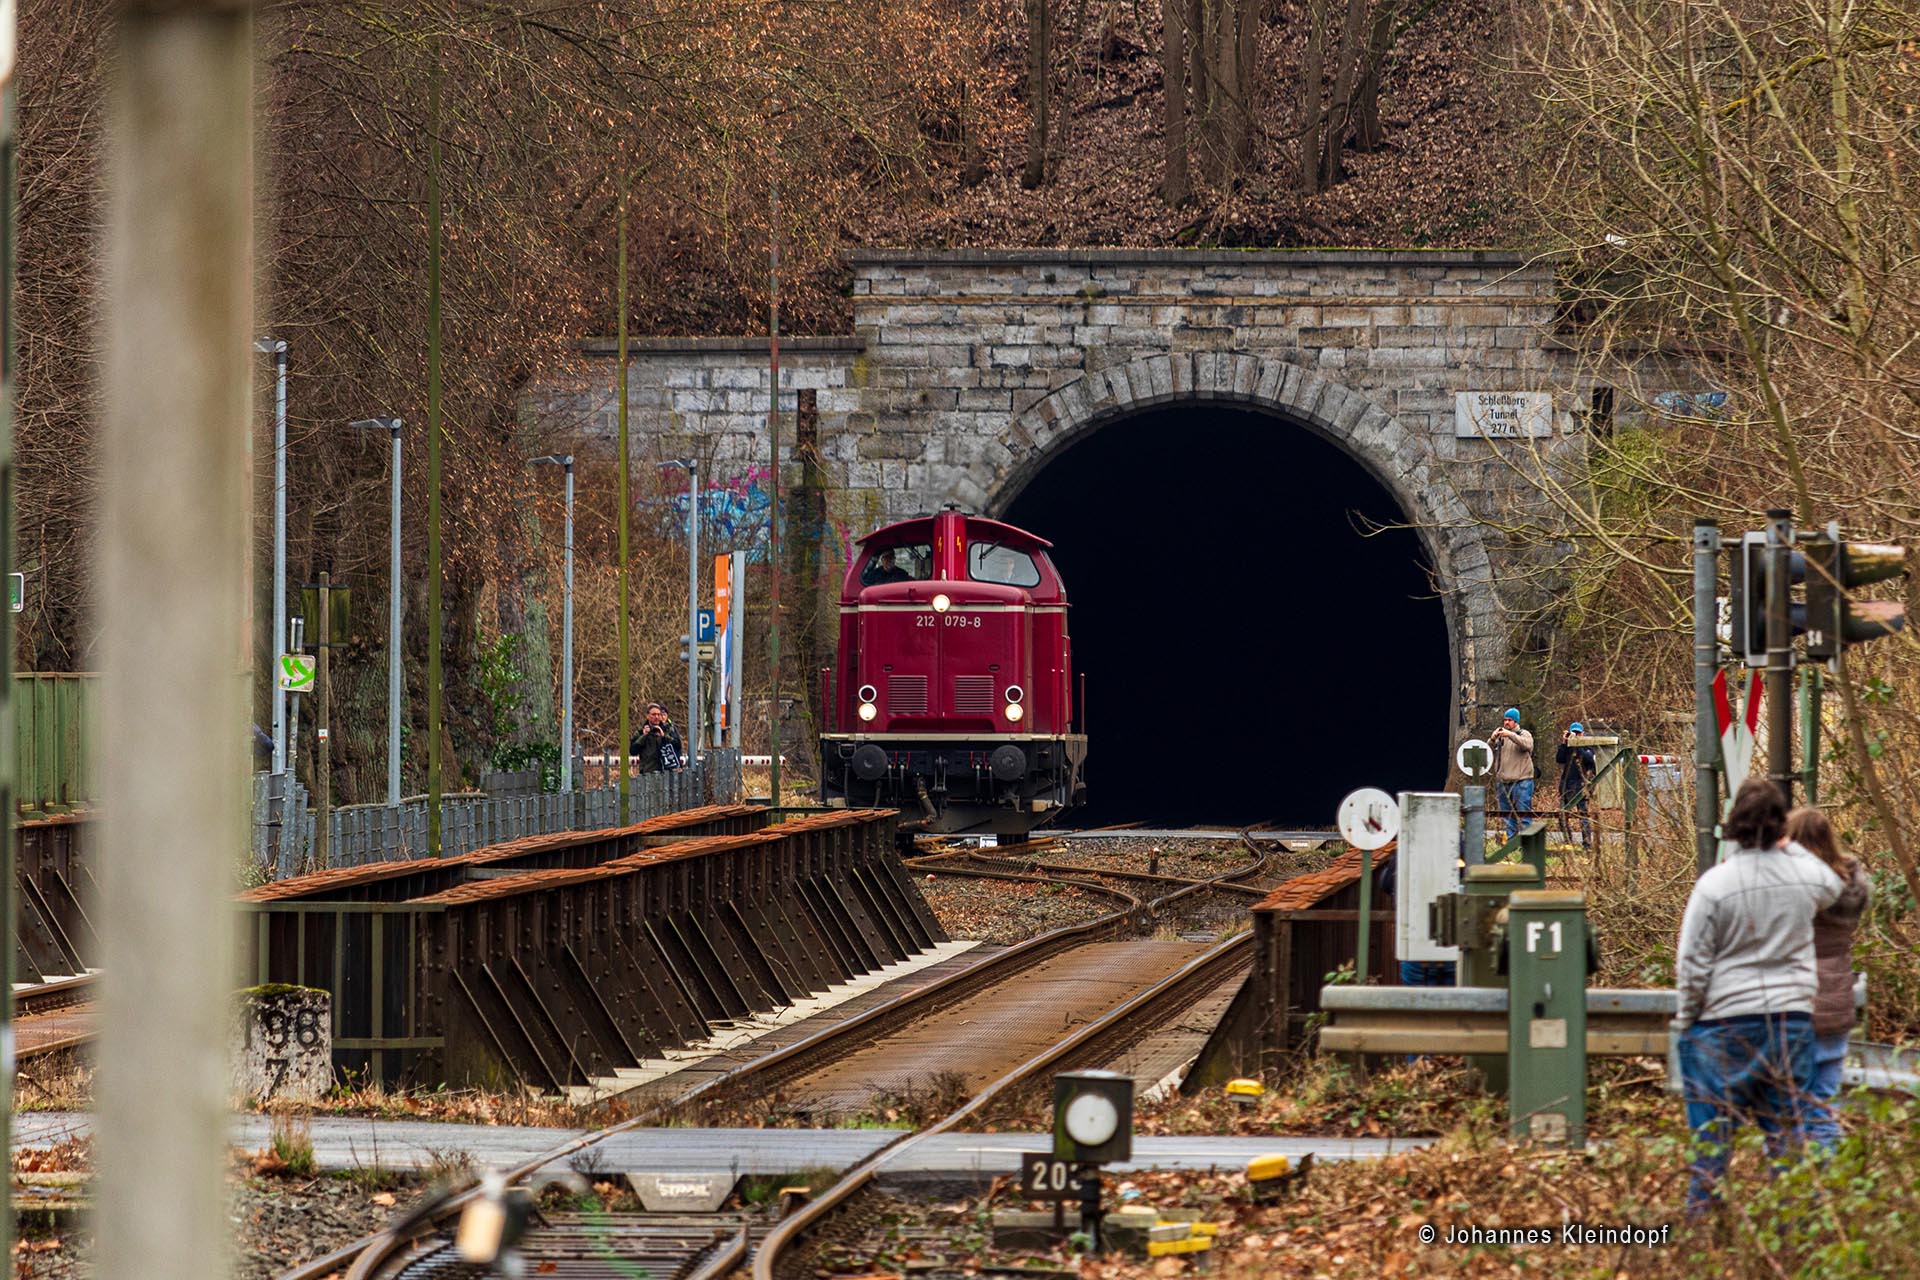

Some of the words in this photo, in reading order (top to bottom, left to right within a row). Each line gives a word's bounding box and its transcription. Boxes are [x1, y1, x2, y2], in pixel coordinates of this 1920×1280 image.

[1491, 423, 1508, 434] 277
[699, 613, 710, 639] P
[916, 615, 935, 627] 212
[944, 615, 981, 628] 079-8
[1526, 921, 1562, 952] F1
[265, 1058, 288, 1097] 7
